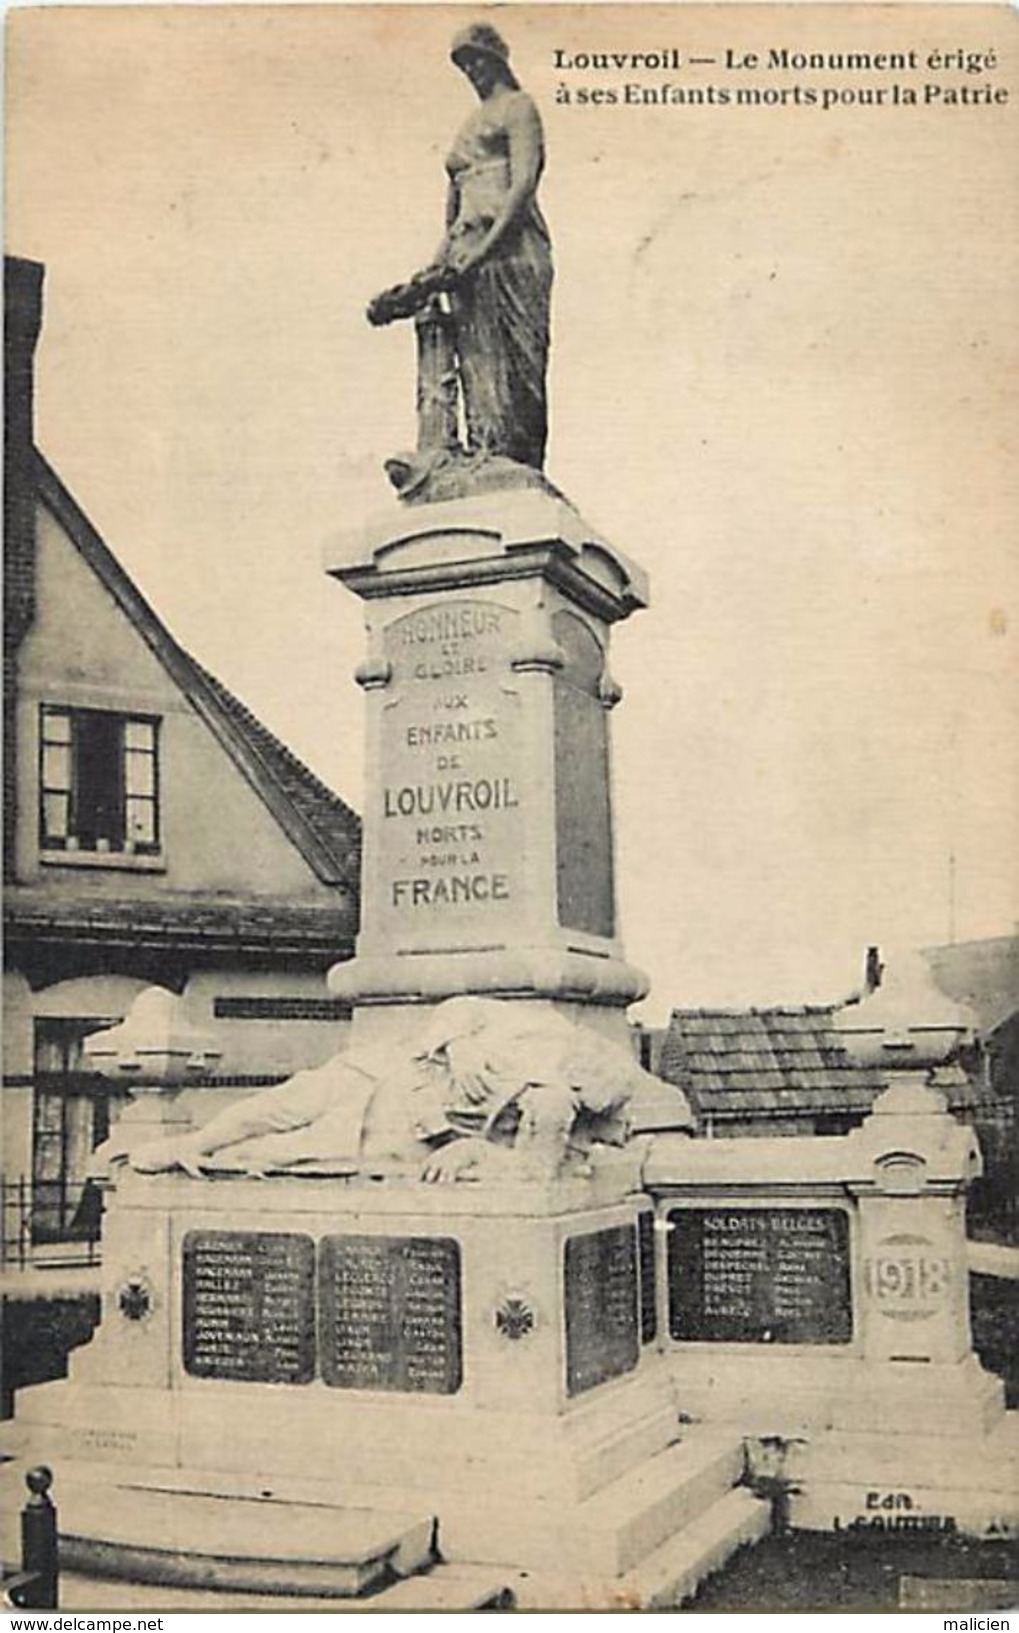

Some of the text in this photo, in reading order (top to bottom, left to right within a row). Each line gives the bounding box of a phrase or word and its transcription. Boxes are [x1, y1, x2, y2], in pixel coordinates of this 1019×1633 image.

[401, 610, 501, 645] HONNEUR
[406, 718, 499, 747] ENFANTS
[436, 755, 462, 771] DE
[384, 777, 520, 818] LOUVROIL
[416, 824, 483, 845] MORTS
[392, 874, 510, 907] FRANCE
[703, 1217, 827, 1231] SOLDATS BELGES
[867, 1257, 948, 1299] 1918
